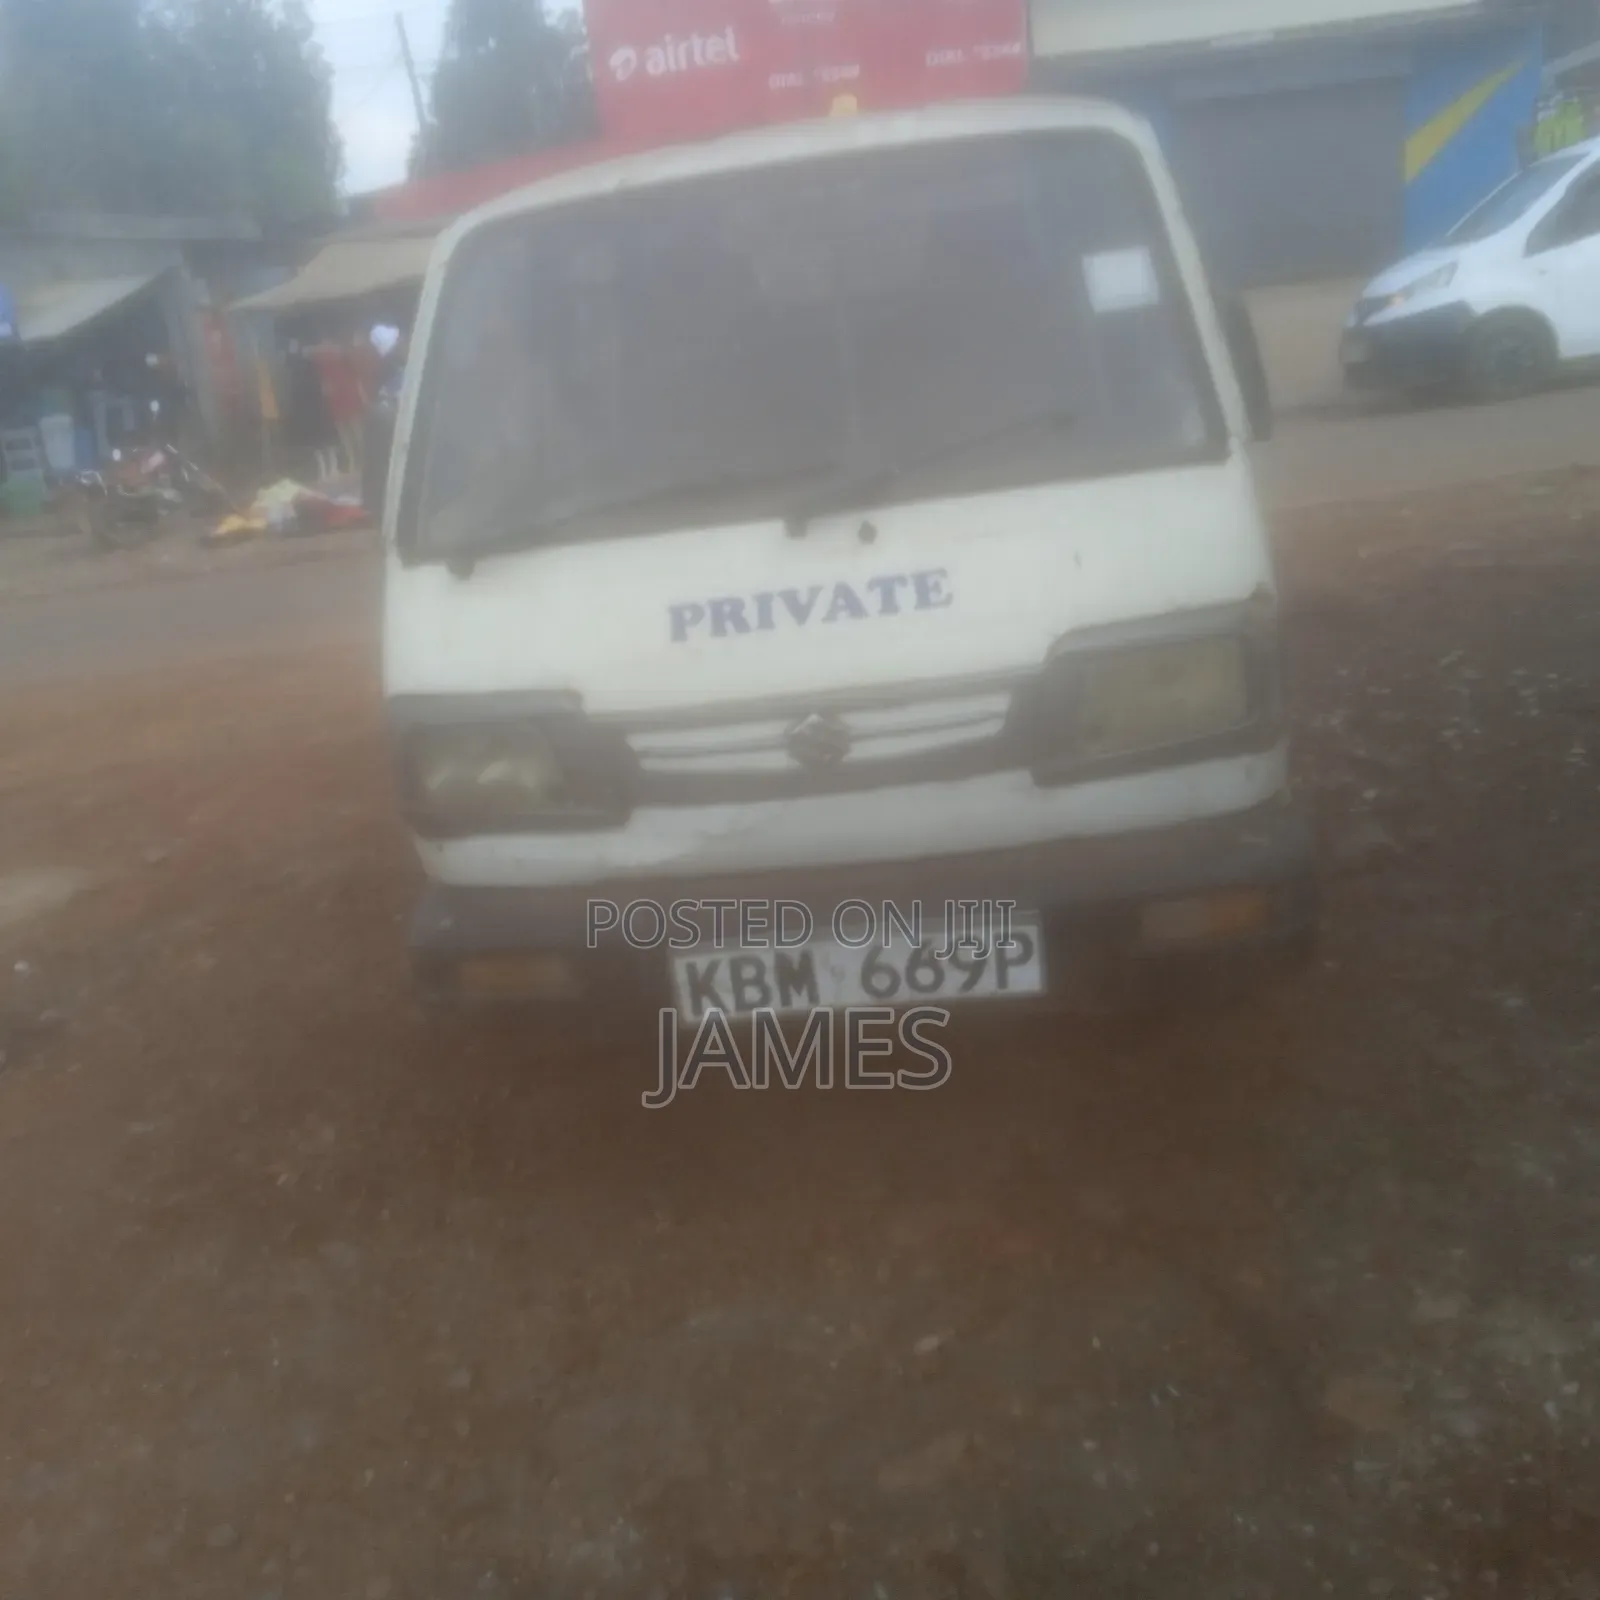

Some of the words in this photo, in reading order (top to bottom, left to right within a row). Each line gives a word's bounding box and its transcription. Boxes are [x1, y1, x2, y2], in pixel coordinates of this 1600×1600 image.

[644, 26, 741, 77] airtel
[668, 566, 955, 643] PRIVATE
[683, 949, 822, 1019] KBM
[860, 931, 1035, 999] 669P
